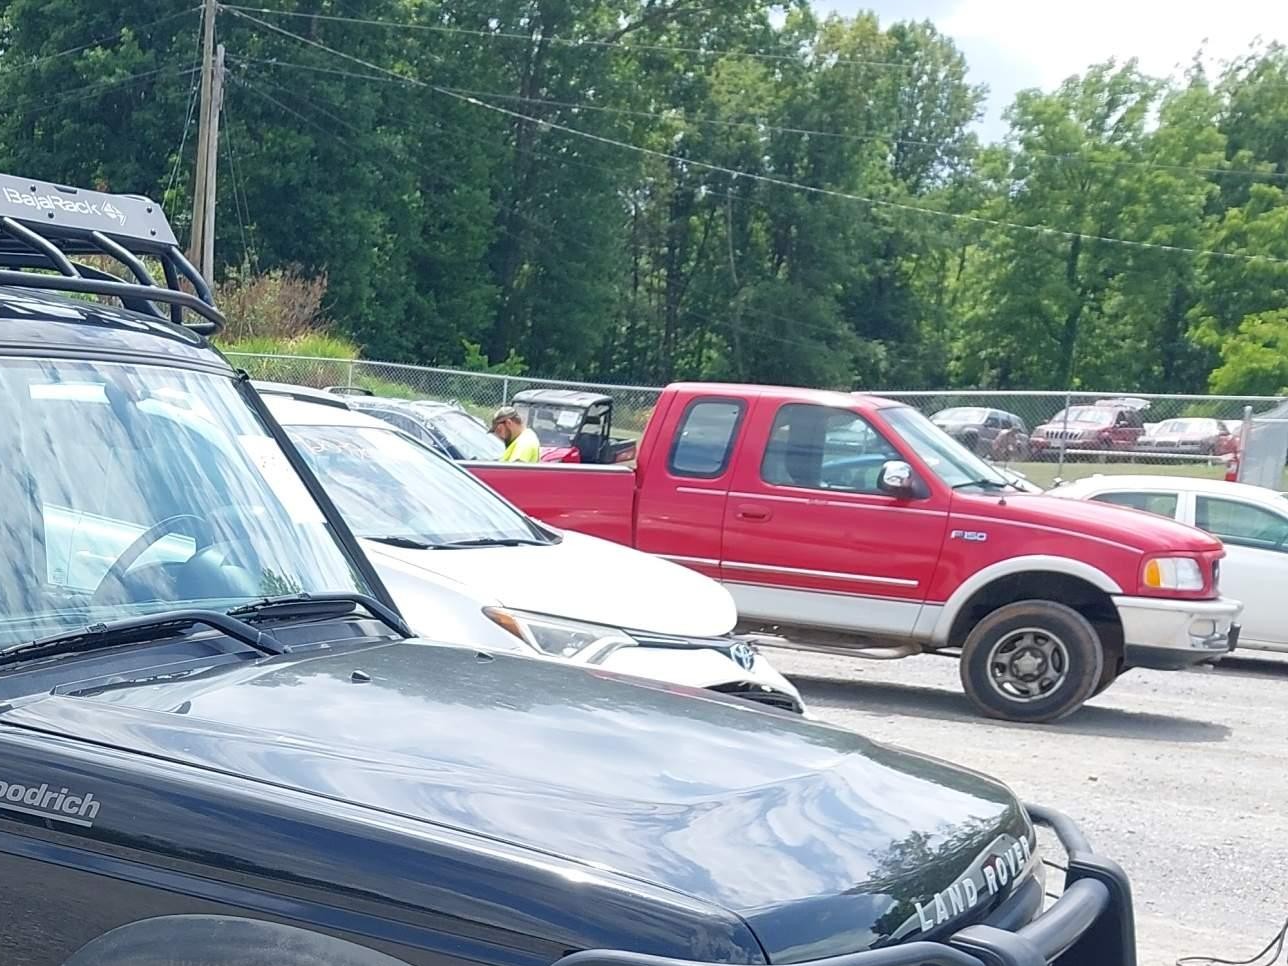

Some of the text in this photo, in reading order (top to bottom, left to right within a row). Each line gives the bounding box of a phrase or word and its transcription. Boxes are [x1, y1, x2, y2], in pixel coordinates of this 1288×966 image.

[2, 187, 102, 216] BajaRack
[914, 834, 1033, 933] LAND ROVER
